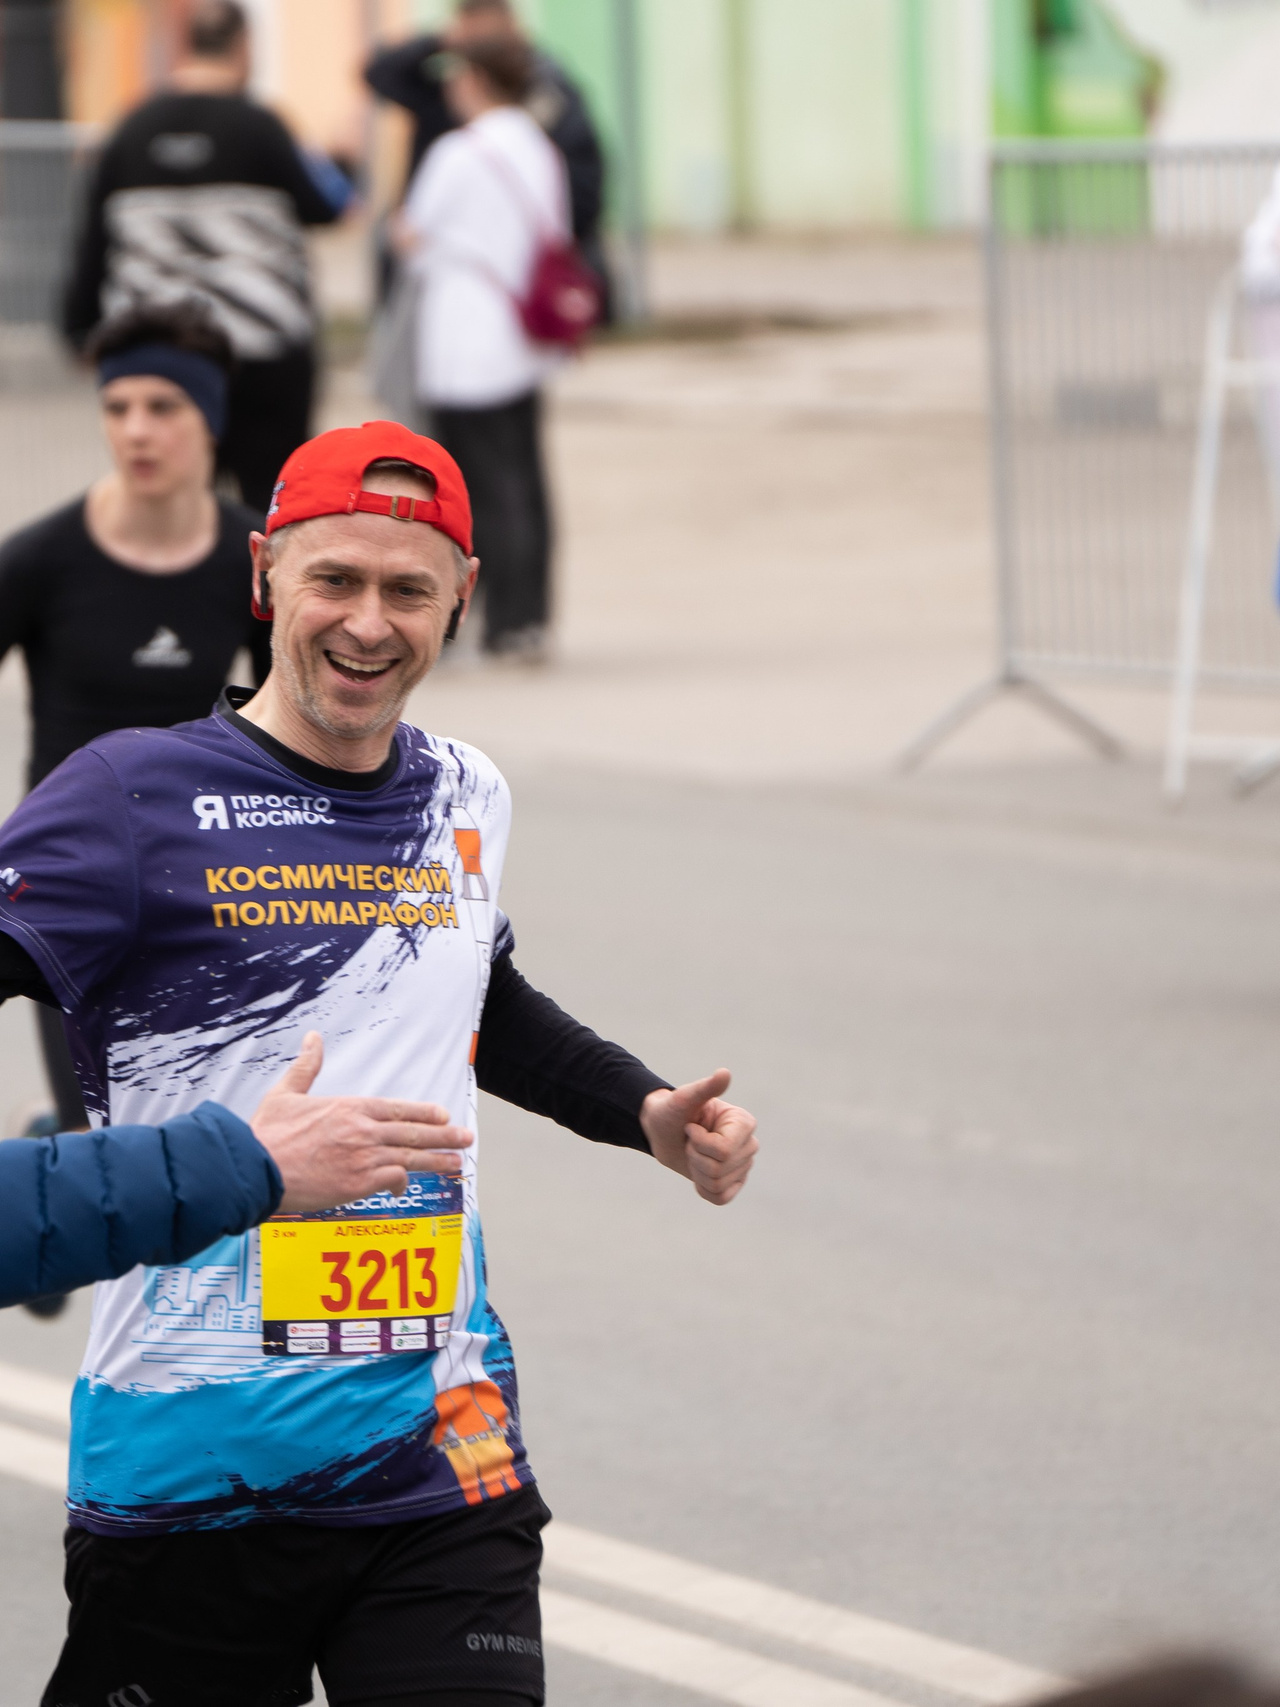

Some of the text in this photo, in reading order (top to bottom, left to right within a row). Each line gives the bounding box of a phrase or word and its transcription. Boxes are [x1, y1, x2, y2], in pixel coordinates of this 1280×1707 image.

[192, 795, 231, 830] Я
[230, 794, 332, 814] ПРОСТО
[205, 862, 452, 894] КОСМИЧЕСКИЙ
[212, 900, 459, 928] ПОЛУМАРАФОН
[272, 1229, 280, 1238] 3
[334, 1223, 417, 1237] АЛЕКСАНДР
[320, 1247, 437, 1312] 3213
[466, 1633, 504, 1652] GYM
